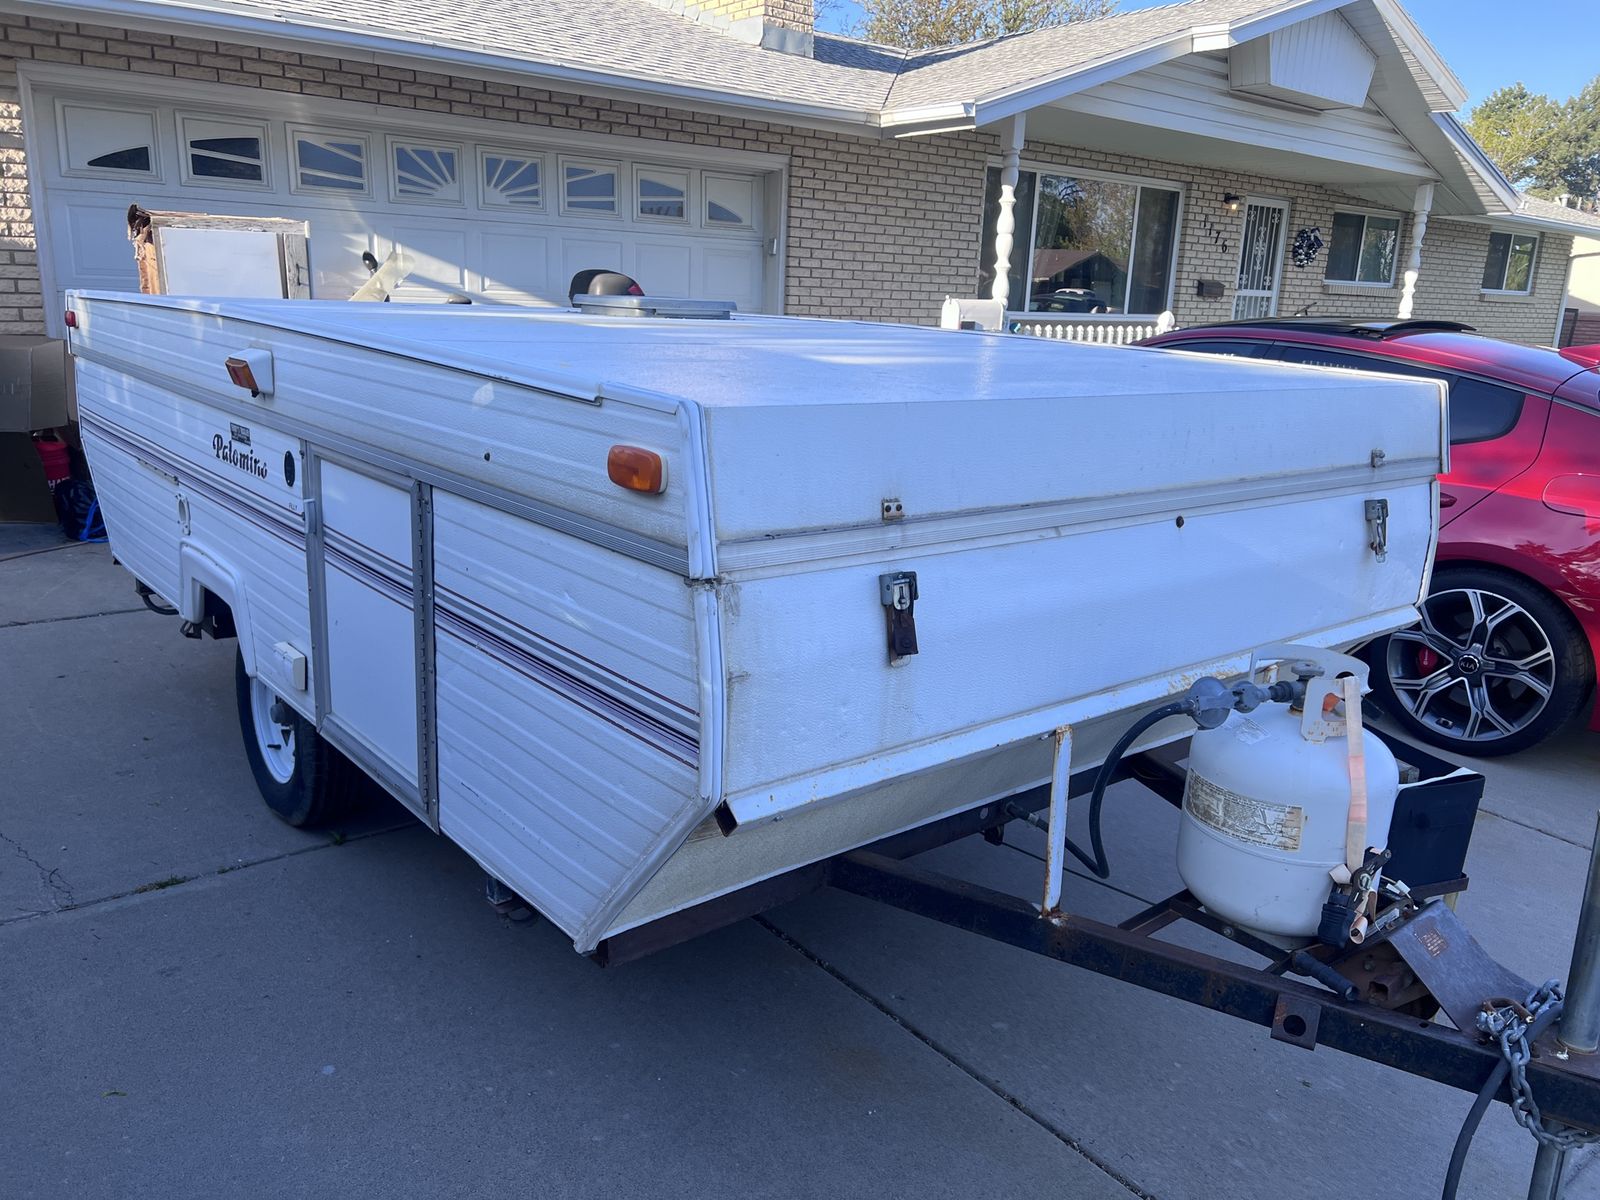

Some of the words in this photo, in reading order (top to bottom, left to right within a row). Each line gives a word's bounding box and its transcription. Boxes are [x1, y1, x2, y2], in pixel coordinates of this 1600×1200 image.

[1203, 215, 1228, 253] 1176
[212, 433, 268, 480] Palomino
[1460, 660, 1475, 670] KIA
